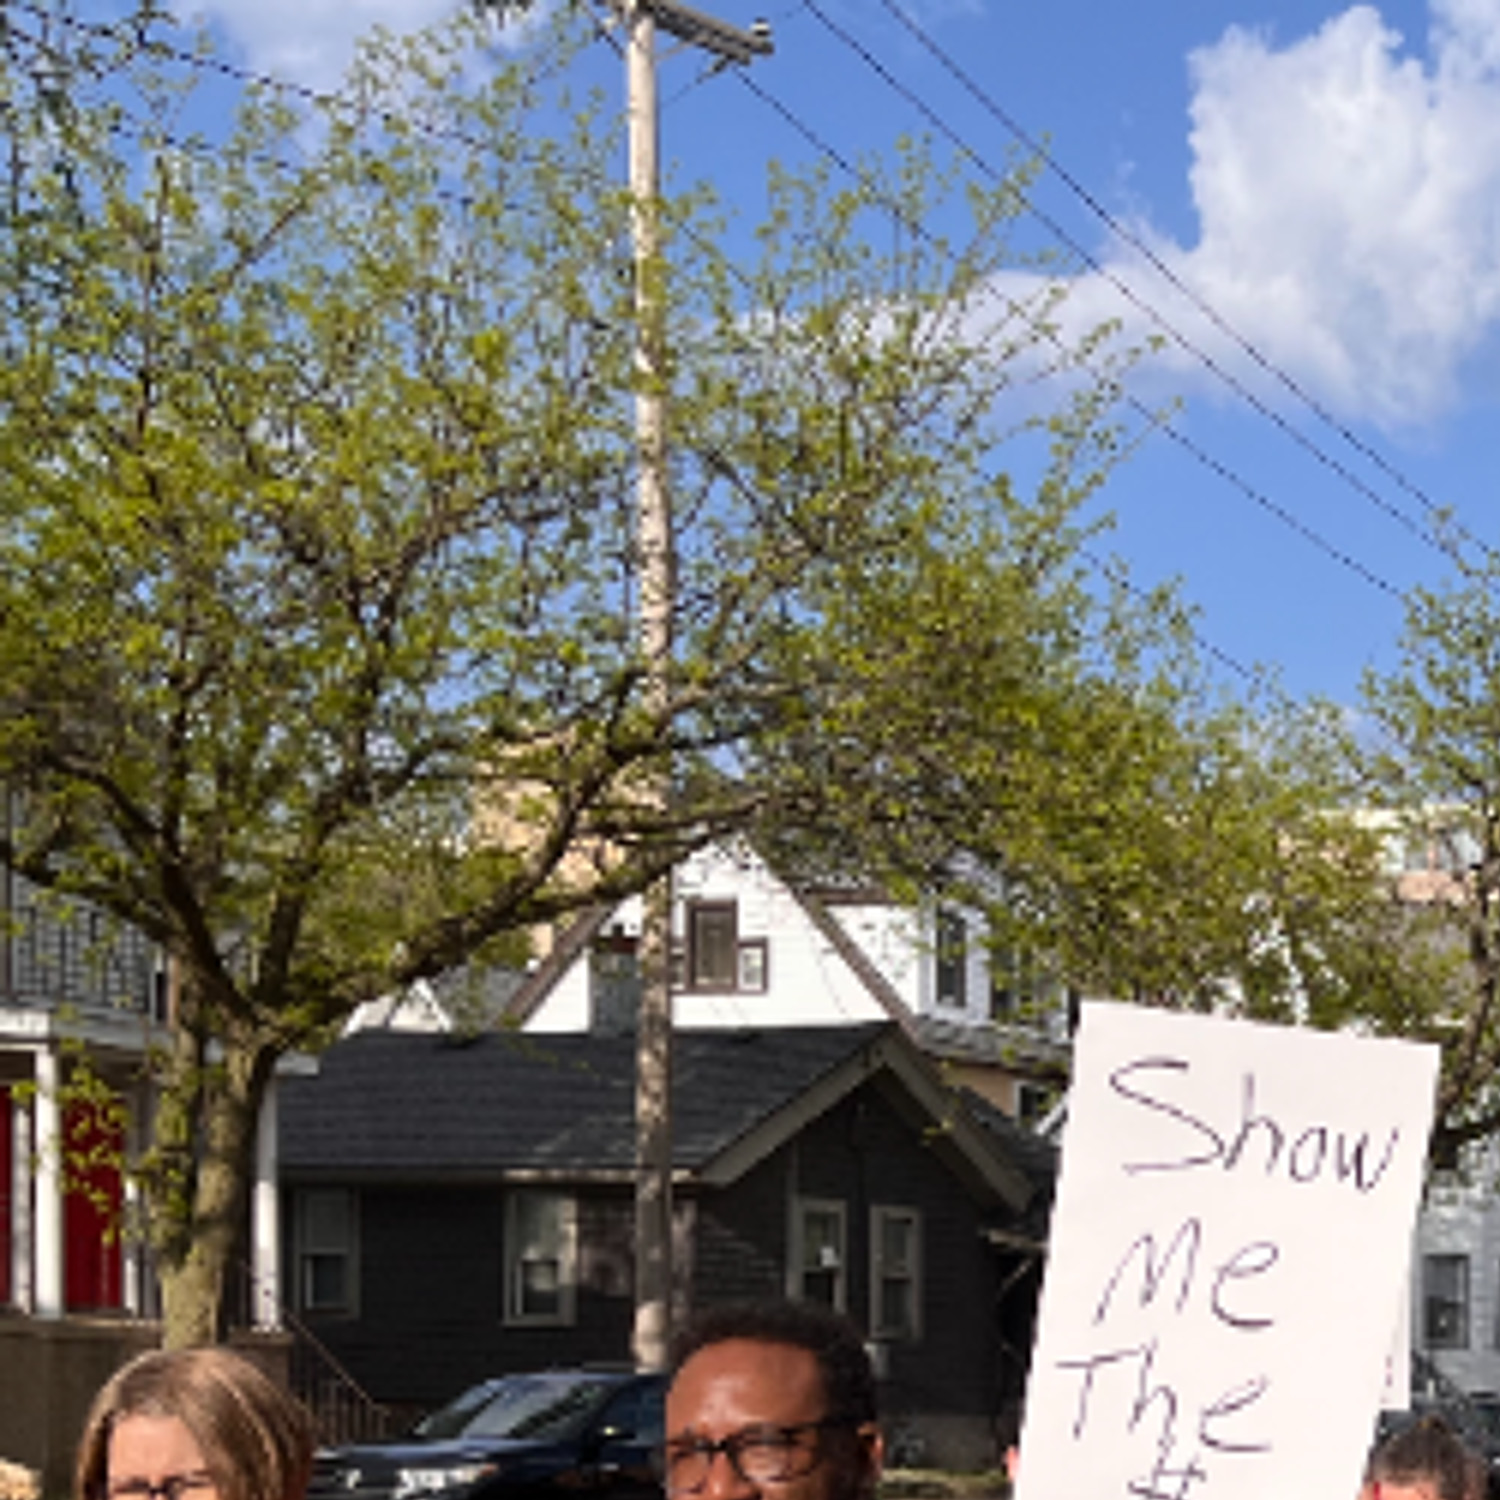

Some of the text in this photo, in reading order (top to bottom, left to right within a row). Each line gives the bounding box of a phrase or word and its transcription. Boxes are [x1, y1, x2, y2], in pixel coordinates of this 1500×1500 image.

[1108, 1055, 1400, 1192] Show
[1092, 1216, 1280, 1330] Me
[1054, 1337, 1272, 1452] The
